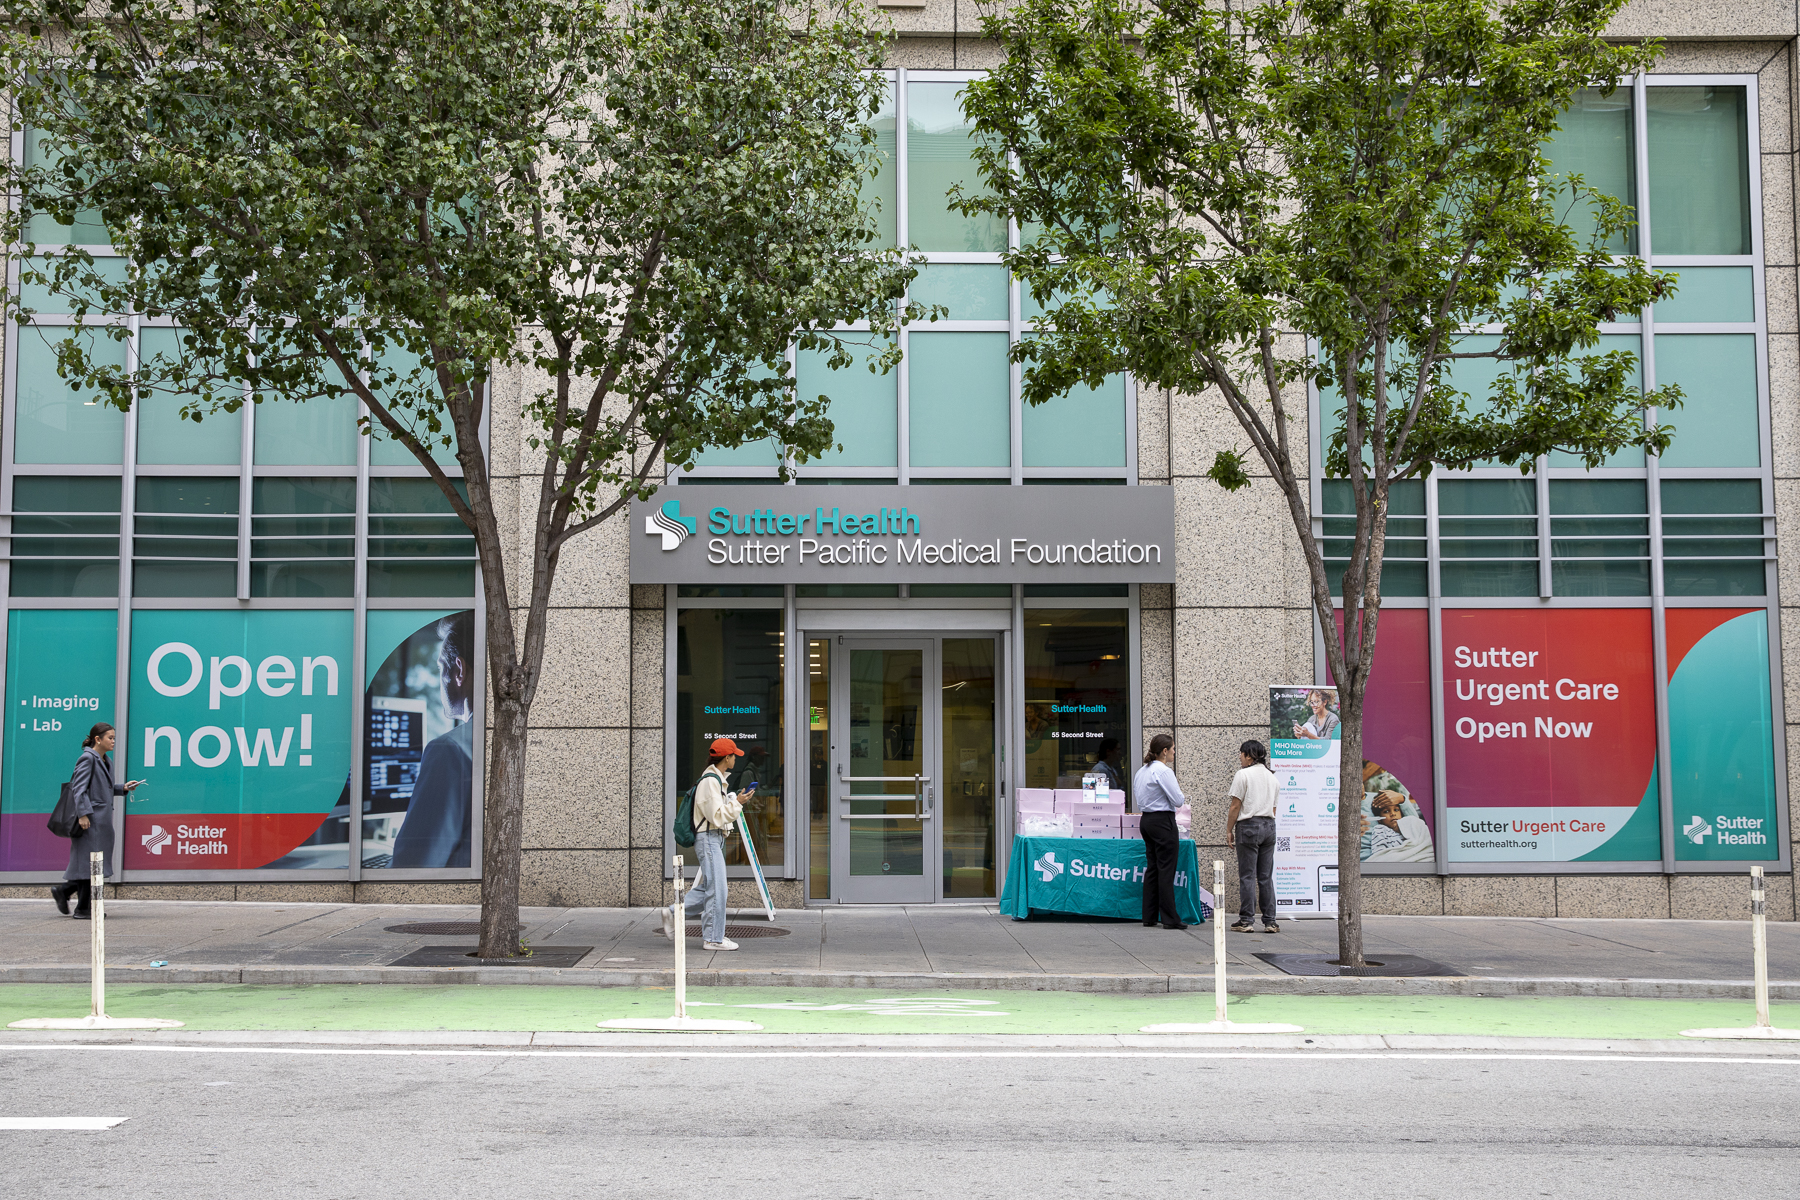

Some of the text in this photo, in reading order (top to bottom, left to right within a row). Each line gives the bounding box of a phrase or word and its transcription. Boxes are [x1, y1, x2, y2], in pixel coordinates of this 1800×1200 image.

[708, 506, 920, 535] Sutter Health
[707, 538, 1161, 564] Sutter Pacific Medical Foundation
[1455, 645, 1539, 668] Sutter
[147, 641, 339, 710] Open
[1456, 678, 1619, 706] Urgent Care
[32, 695, 99, 711] Imaging
[704, 705, 760, 714] Sutter Health
[1052, 704, 1107, 713] Sutter Health
[33, 718, 62, 732] Lab
[1455, 716, 1593, 743] Open Now
[144, 713, 313, 768] now!
[1461, 820, 1606, 836] Sutter Urgent Care
[1716, 815, 1764, 829] Sutter
[177, 825, 227, 839] Sutter
[1717, 831, 1767, 845] Health
[177, 840, 228, 855] Health
[1460, 839, 1537, 850] sutterhealth.org
[1070, 859, 1188, 889] Sutter Hth
